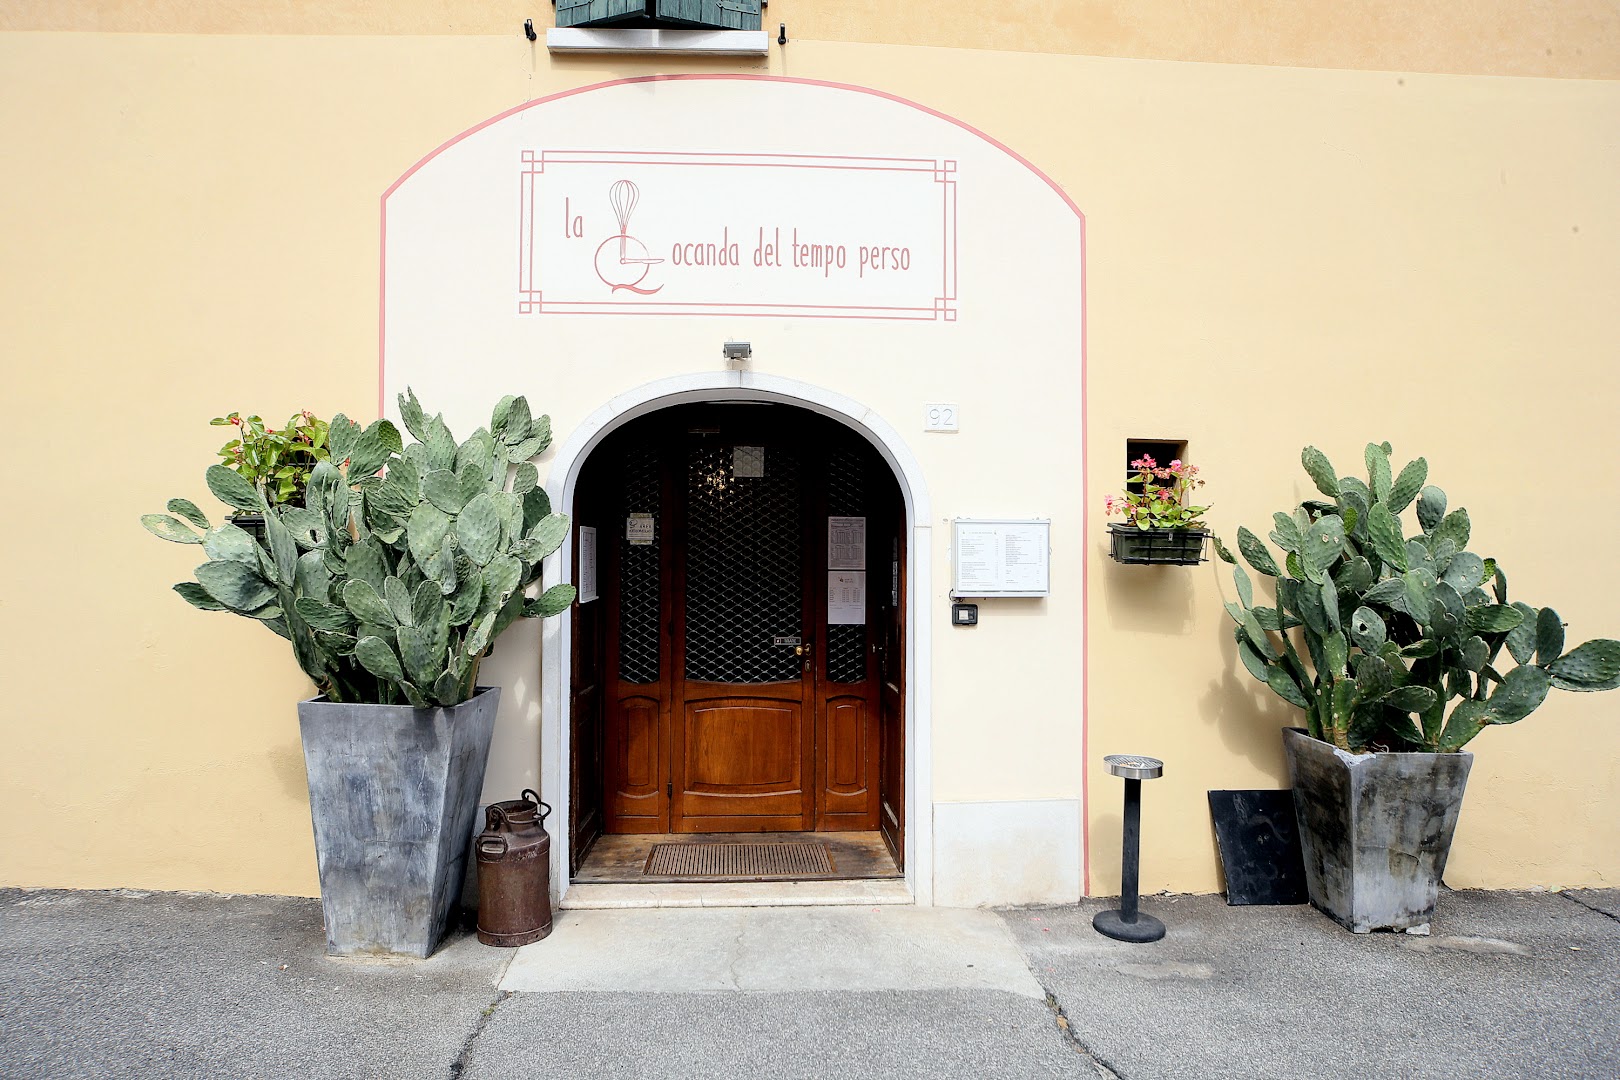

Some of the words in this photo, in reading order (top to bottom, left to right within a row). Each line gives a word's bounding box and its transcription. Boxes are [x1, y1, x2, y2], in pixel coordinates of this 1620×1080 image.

[566, 197, 583, 239] la
[753, 227, 782, 267] del
[792, 228, 846, 278] tempo
[859, 246, 911, 279] perso
[930, 408, 954, 426] 92
